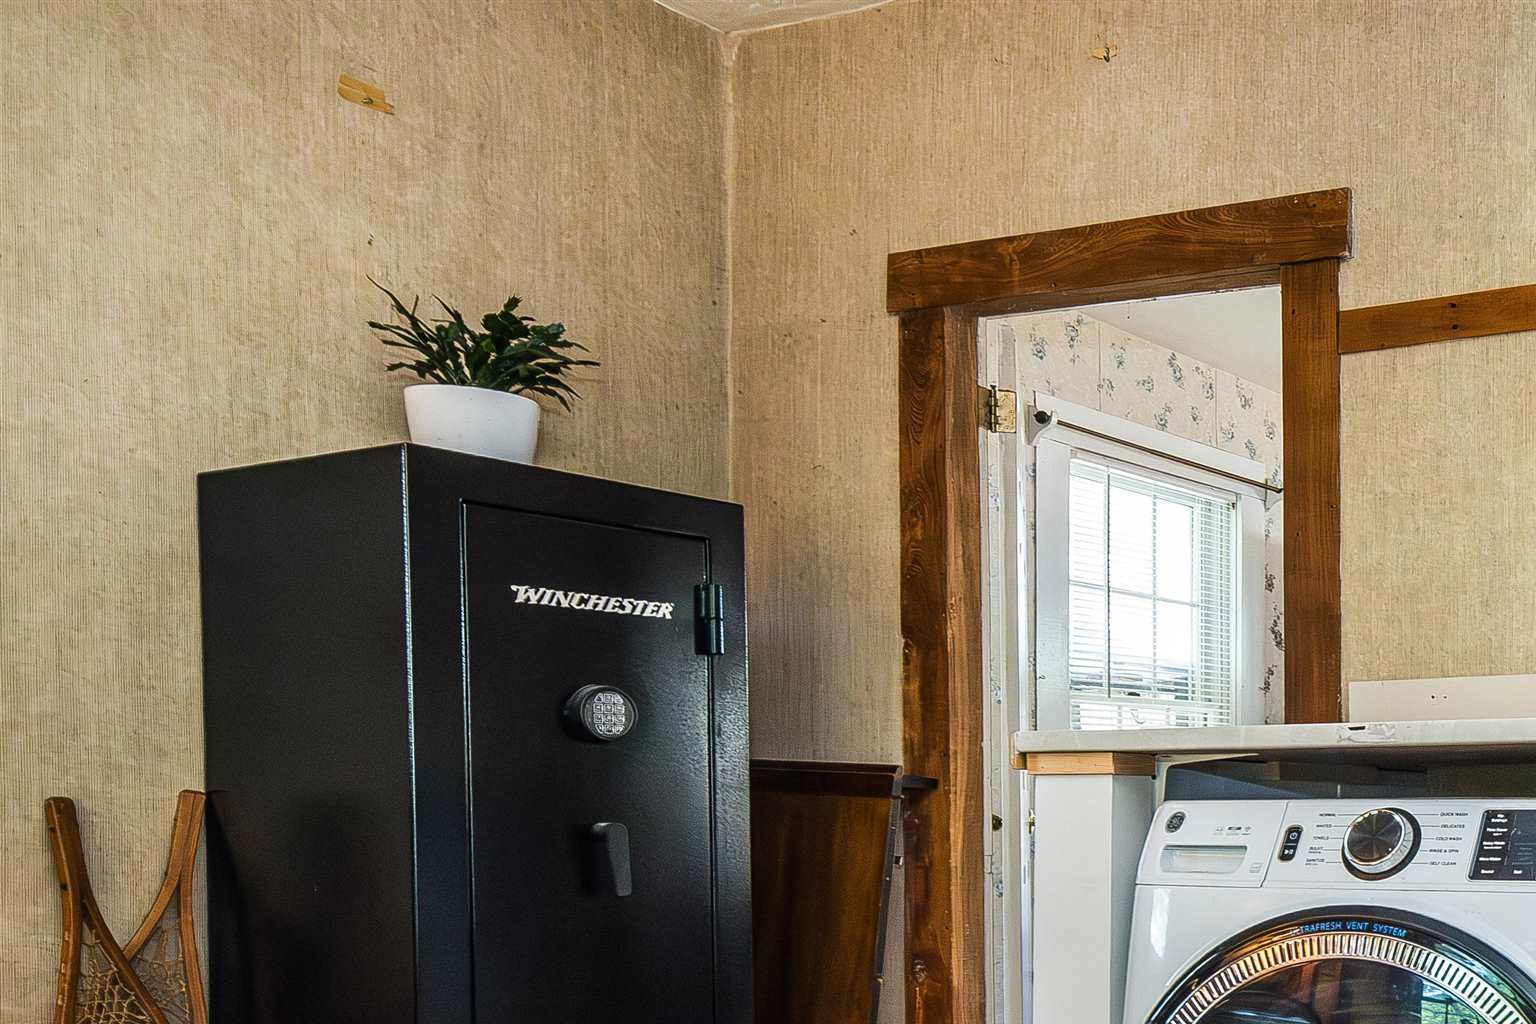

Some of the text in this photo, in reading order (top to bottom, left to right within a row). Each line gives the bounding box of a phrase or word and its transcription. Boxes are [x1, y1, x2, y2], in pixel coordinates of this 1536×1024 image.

[510, 584, 674, 620] WINCHESTER
[1346, 922, 1369, 930] VENT
[1373, 924, 1407, 938] SYSTEM
